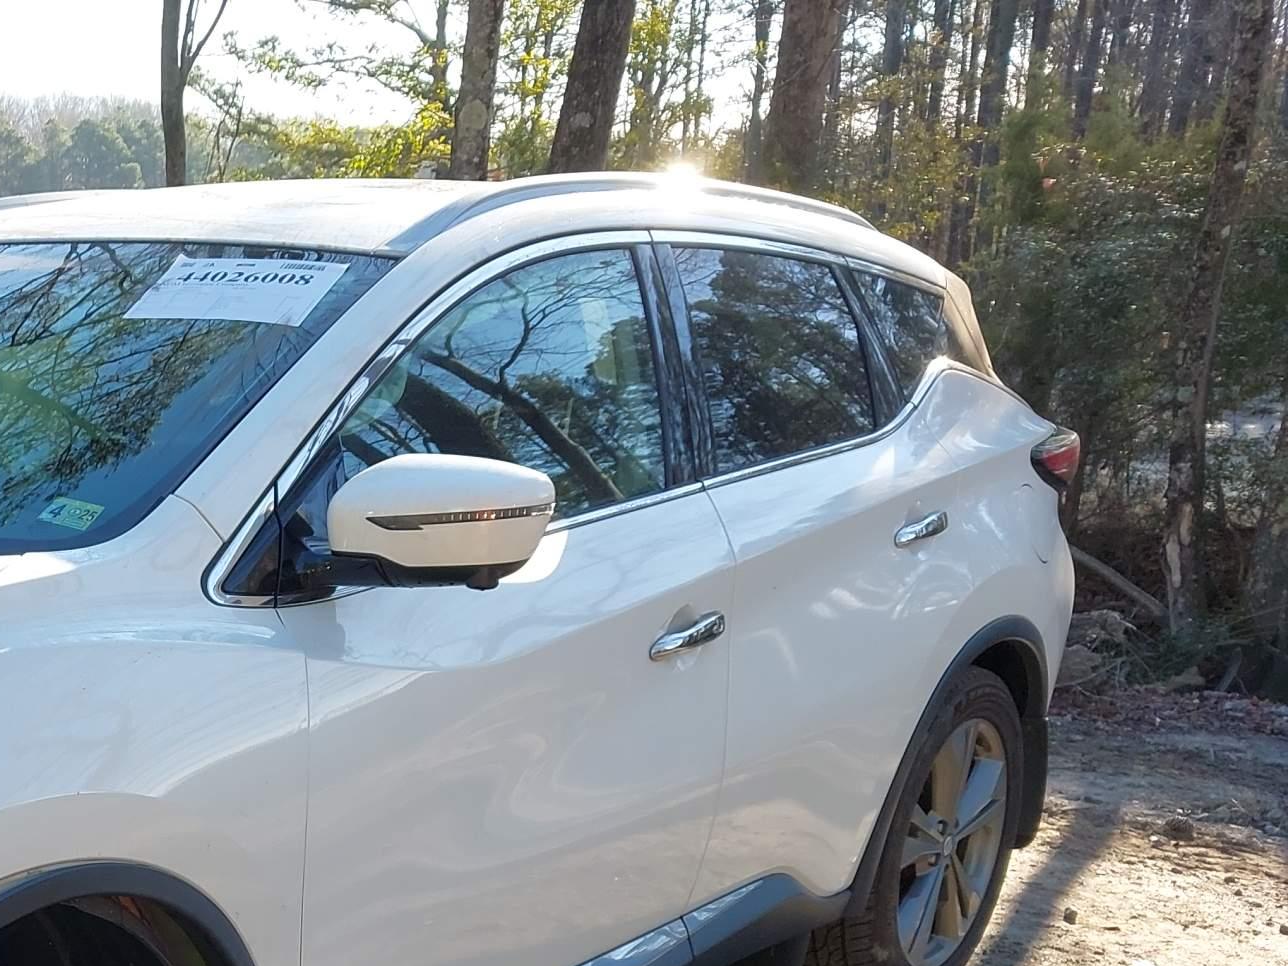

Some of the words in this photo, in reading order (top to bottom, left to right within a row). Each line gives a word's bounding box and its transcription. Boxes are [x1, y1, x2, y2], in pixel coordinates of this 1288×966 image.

[176, 270, 315, 286] 44026008
[48, 503, 68, 518] 4
[78, 509, 98, 522] 25
